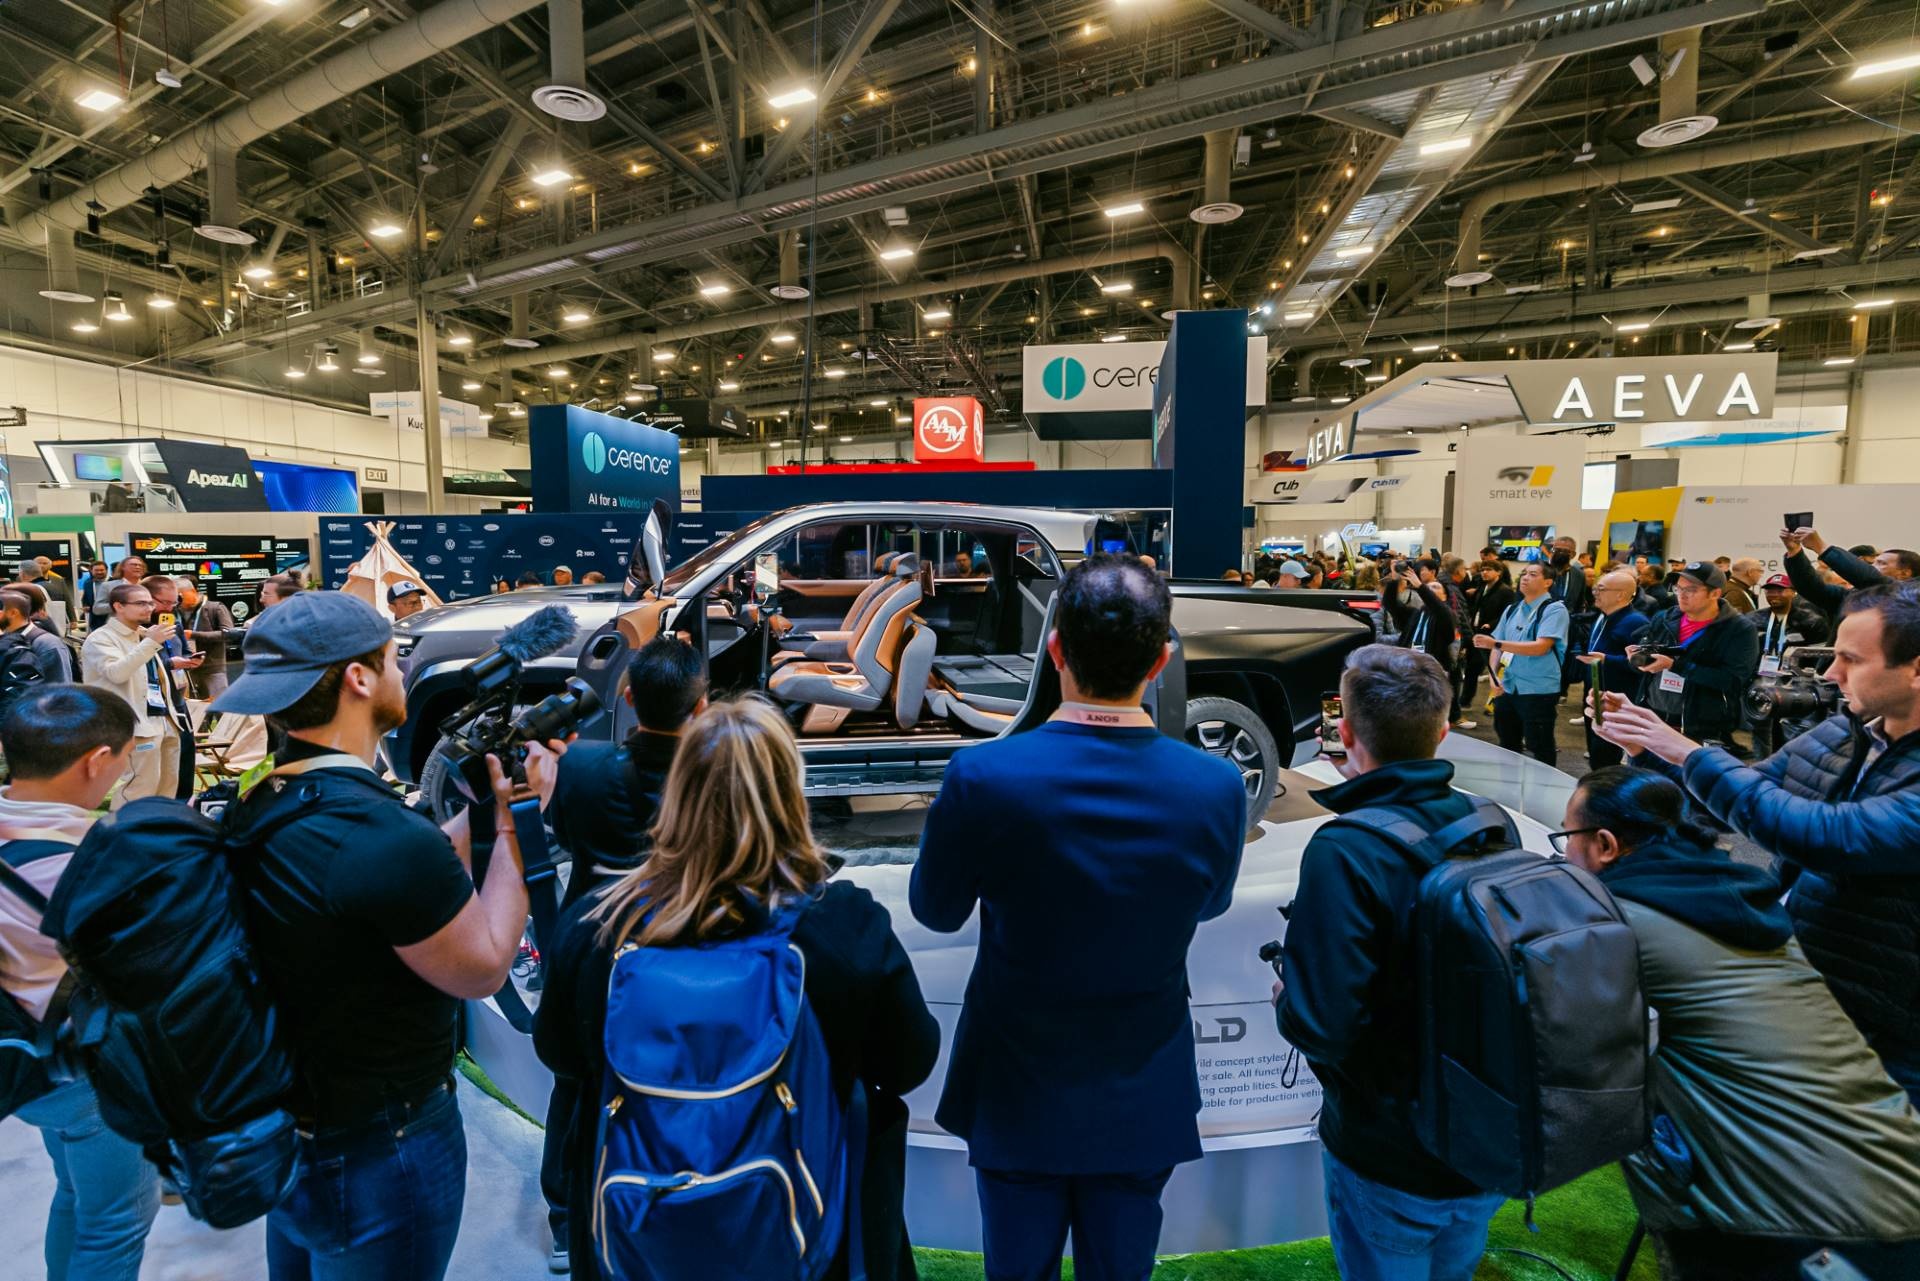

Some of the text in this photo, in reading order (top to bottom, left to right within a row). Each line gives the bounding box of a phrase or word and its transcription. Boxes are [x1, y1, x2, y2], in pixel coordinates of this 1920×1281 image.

[1552, 372, 1760, 419] AEVA
[924, 412, 968, 442] AAM
[1306, 422, 1345, 466] AEVA
[187, 468, 248, 489] Apex.AI
[367, 470, 387, 481] EXIT
[588, 493, 598, 505] AI
[600, 494, 611, 506] for
[612, 498, 618, 507] a
[619, 496, 641, 509] World
[1489, 488, 1553, 501] smart eye
[1086, 714, 1119, 723] SONY
[1197, 1053, 1287, 1068] ild concept styled
[1229, 1097, 1243, 1106] for
[1246, 1091, 1299, 1106] production
